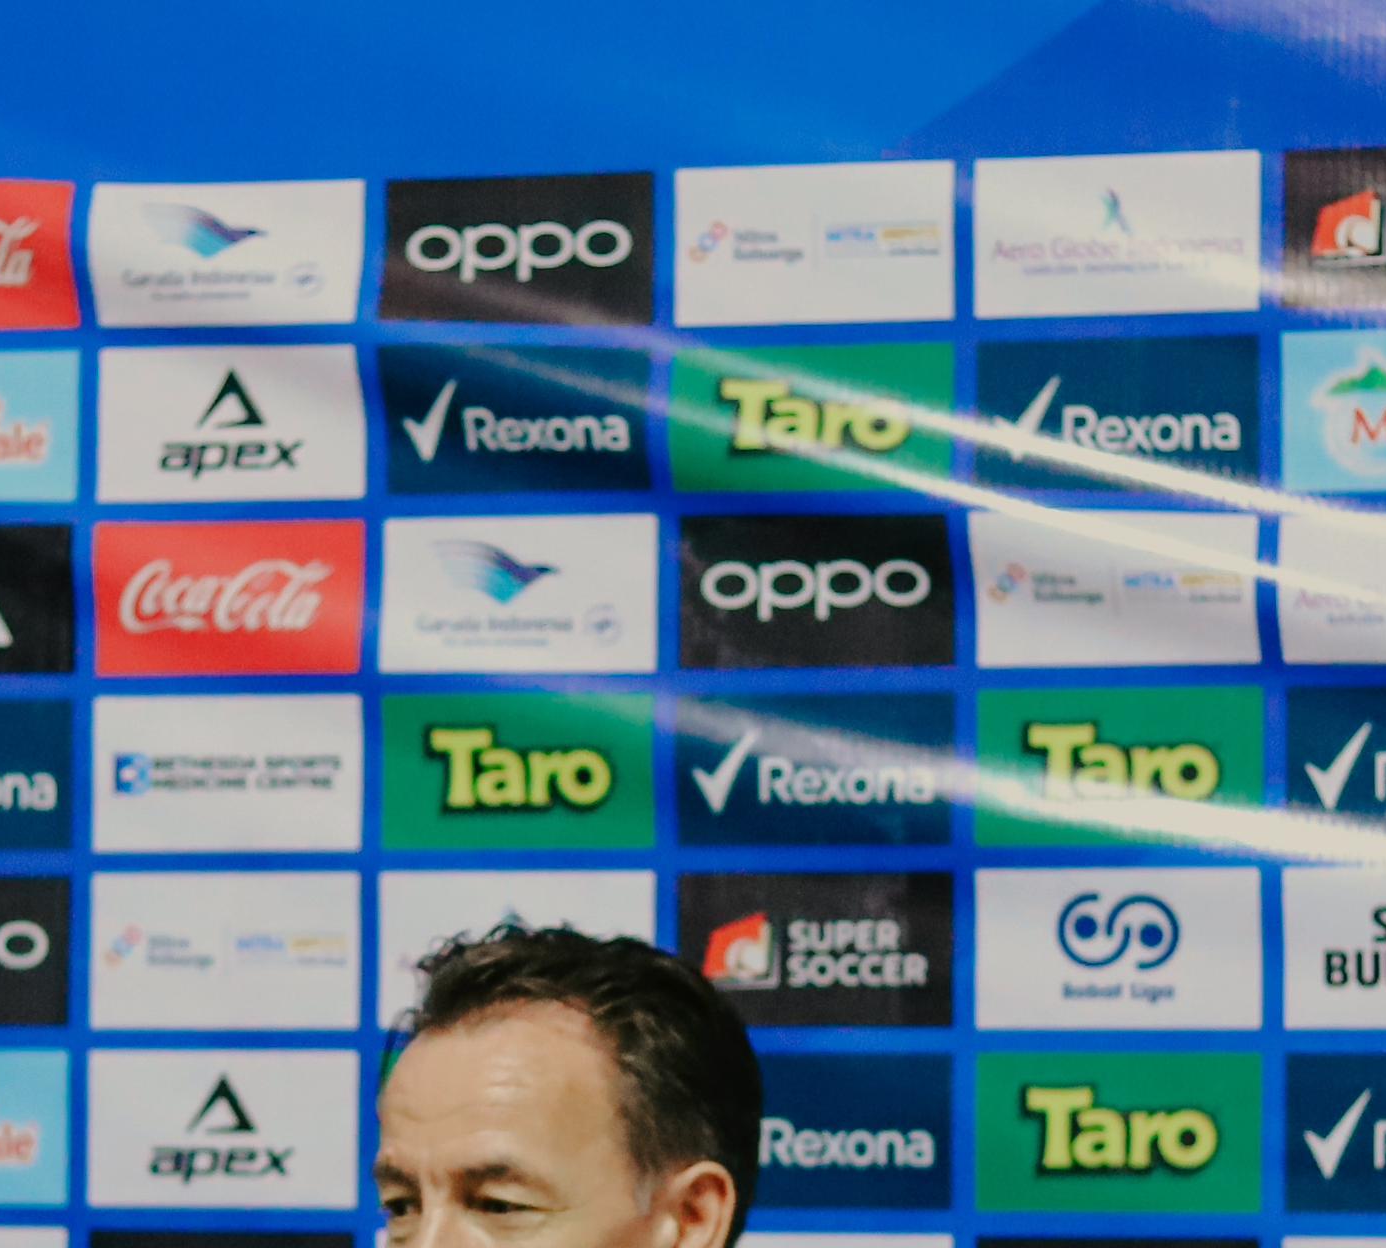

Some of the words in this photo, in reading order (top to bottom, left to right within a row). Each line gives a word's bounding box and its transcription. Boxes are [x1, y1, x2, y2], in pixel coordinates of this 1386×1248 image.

[406, 219, 633, 283] oppo
[465, 408, 631, 454] Rexona
[719, 378, 912, 454] Taro
[1061, 404, 1242, 454] Rexona
[700, 558, 932, 622] oppo
[428, 725, 611, 809] Taro
[758, 756, 936, 805] Rexona
[1026, 721, 1220, 800] Taro
[787, 920, 901, 953] SUPER
[787, 954, 929, 988] SOCCER
[759, 1118, 936, 1167] Rexona
[1024, 1086, 1216, 1170] Taro
